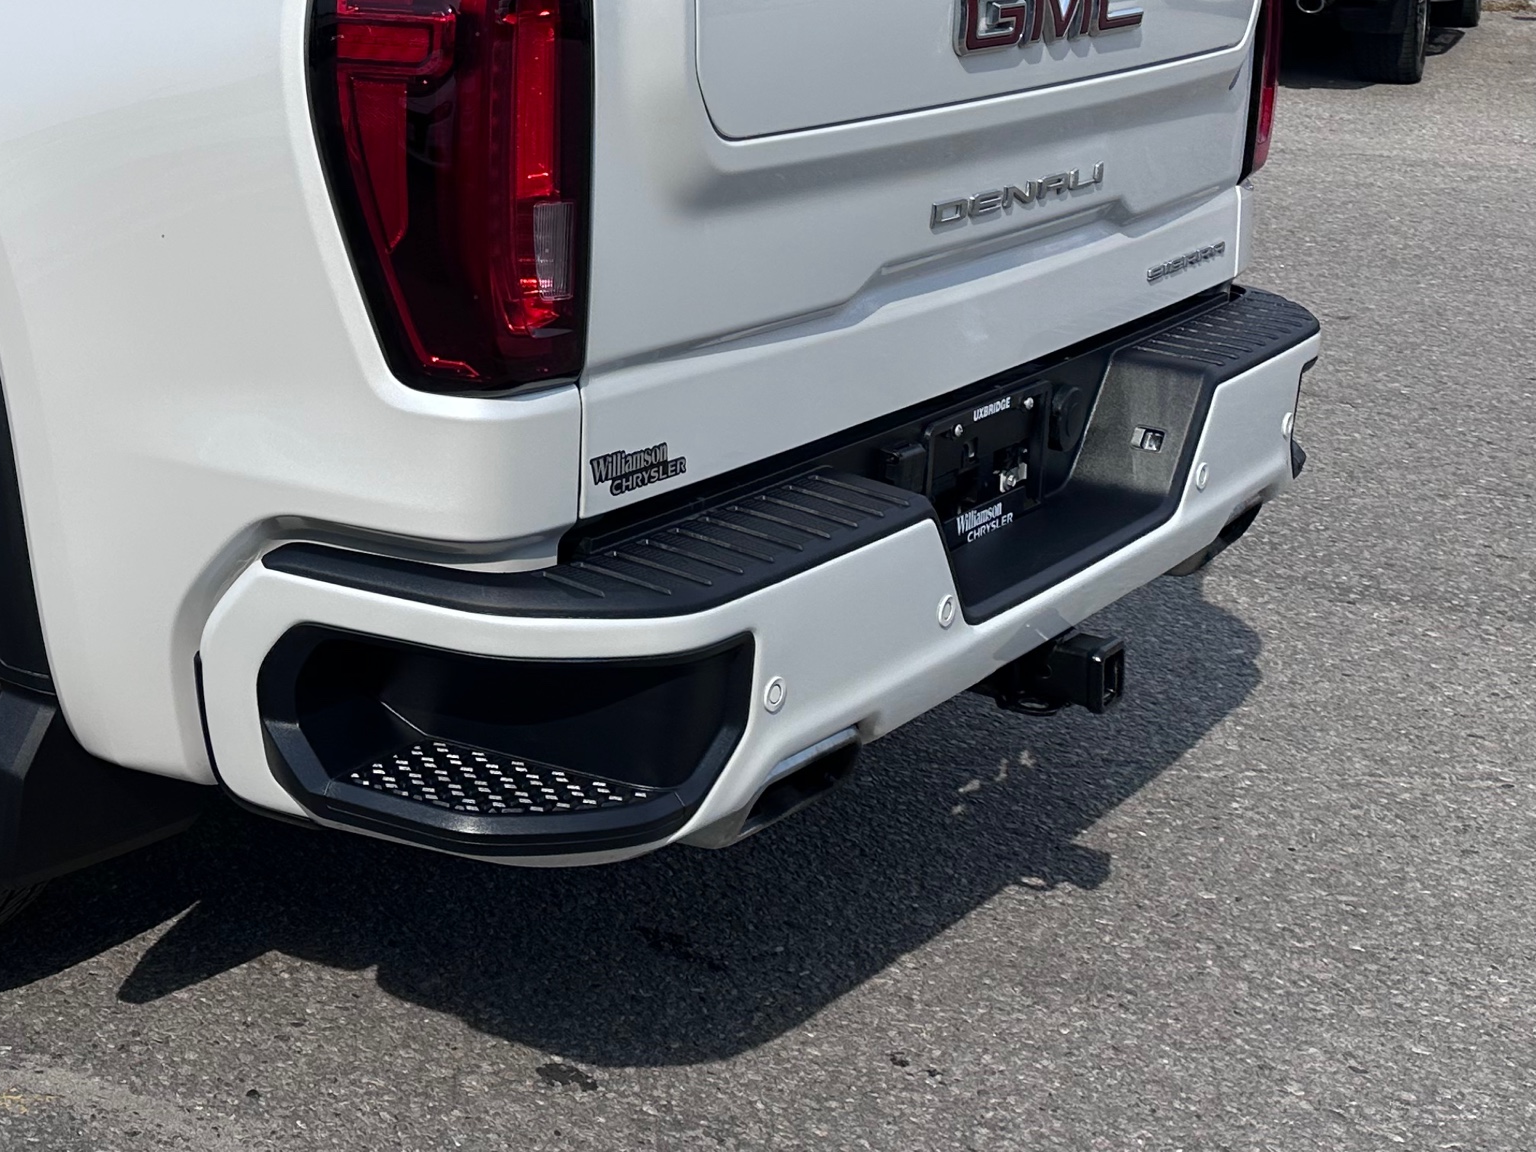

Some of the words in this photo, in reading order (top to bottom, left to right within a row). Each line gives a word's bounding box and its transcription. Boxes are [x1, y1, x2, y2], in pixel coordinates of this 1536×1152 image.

[929, 160, 1105, 230] DENALI
[1146, 241, 1226, 282] SIERRA
[973, 396, 1011, 422] UXBRIDGE
[591, 443, 668, 485] Williamson
[611, 458, 686, 496] CHRYSLER
[956, 502, 1003, 537] Williamson
[967, 512, 1014, 543] CHRYSLER
